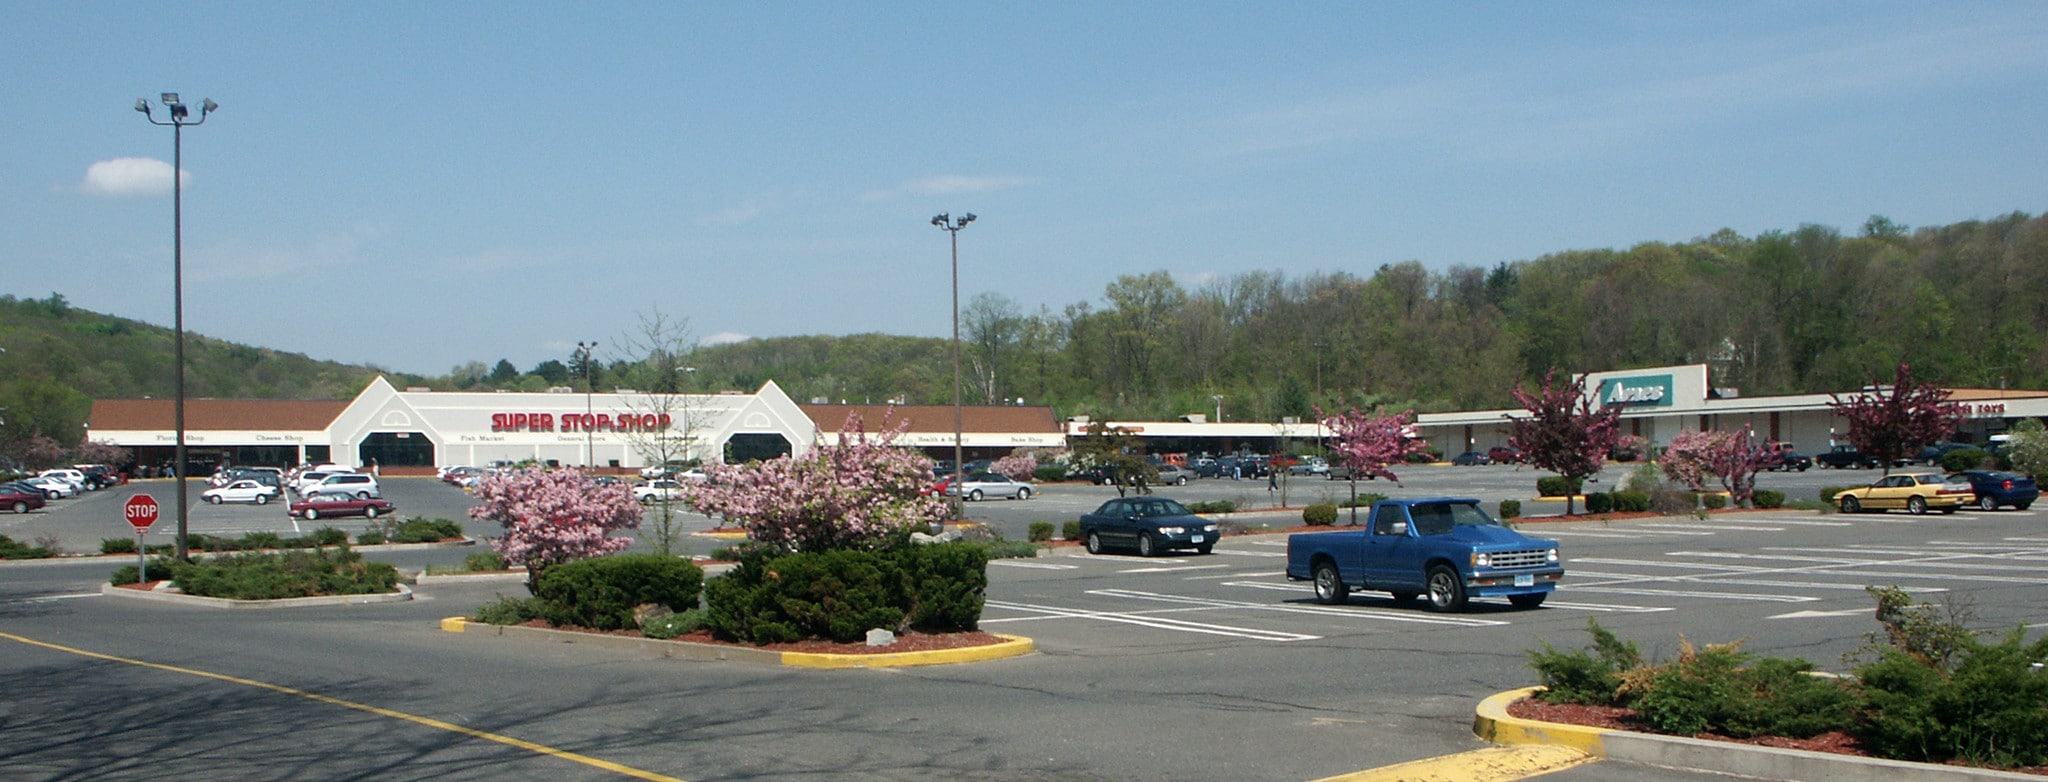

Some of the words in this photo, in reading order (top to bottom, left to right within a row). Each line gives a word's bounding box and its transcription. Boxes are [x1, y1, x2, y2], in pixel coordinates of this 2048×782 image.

[1607, 382, 1665, 403] Ames
[1978, 403, 2005, 413] TOYS
[491, 413, 554, 430] SUPER
[127, 504, 157, 518] STOP
